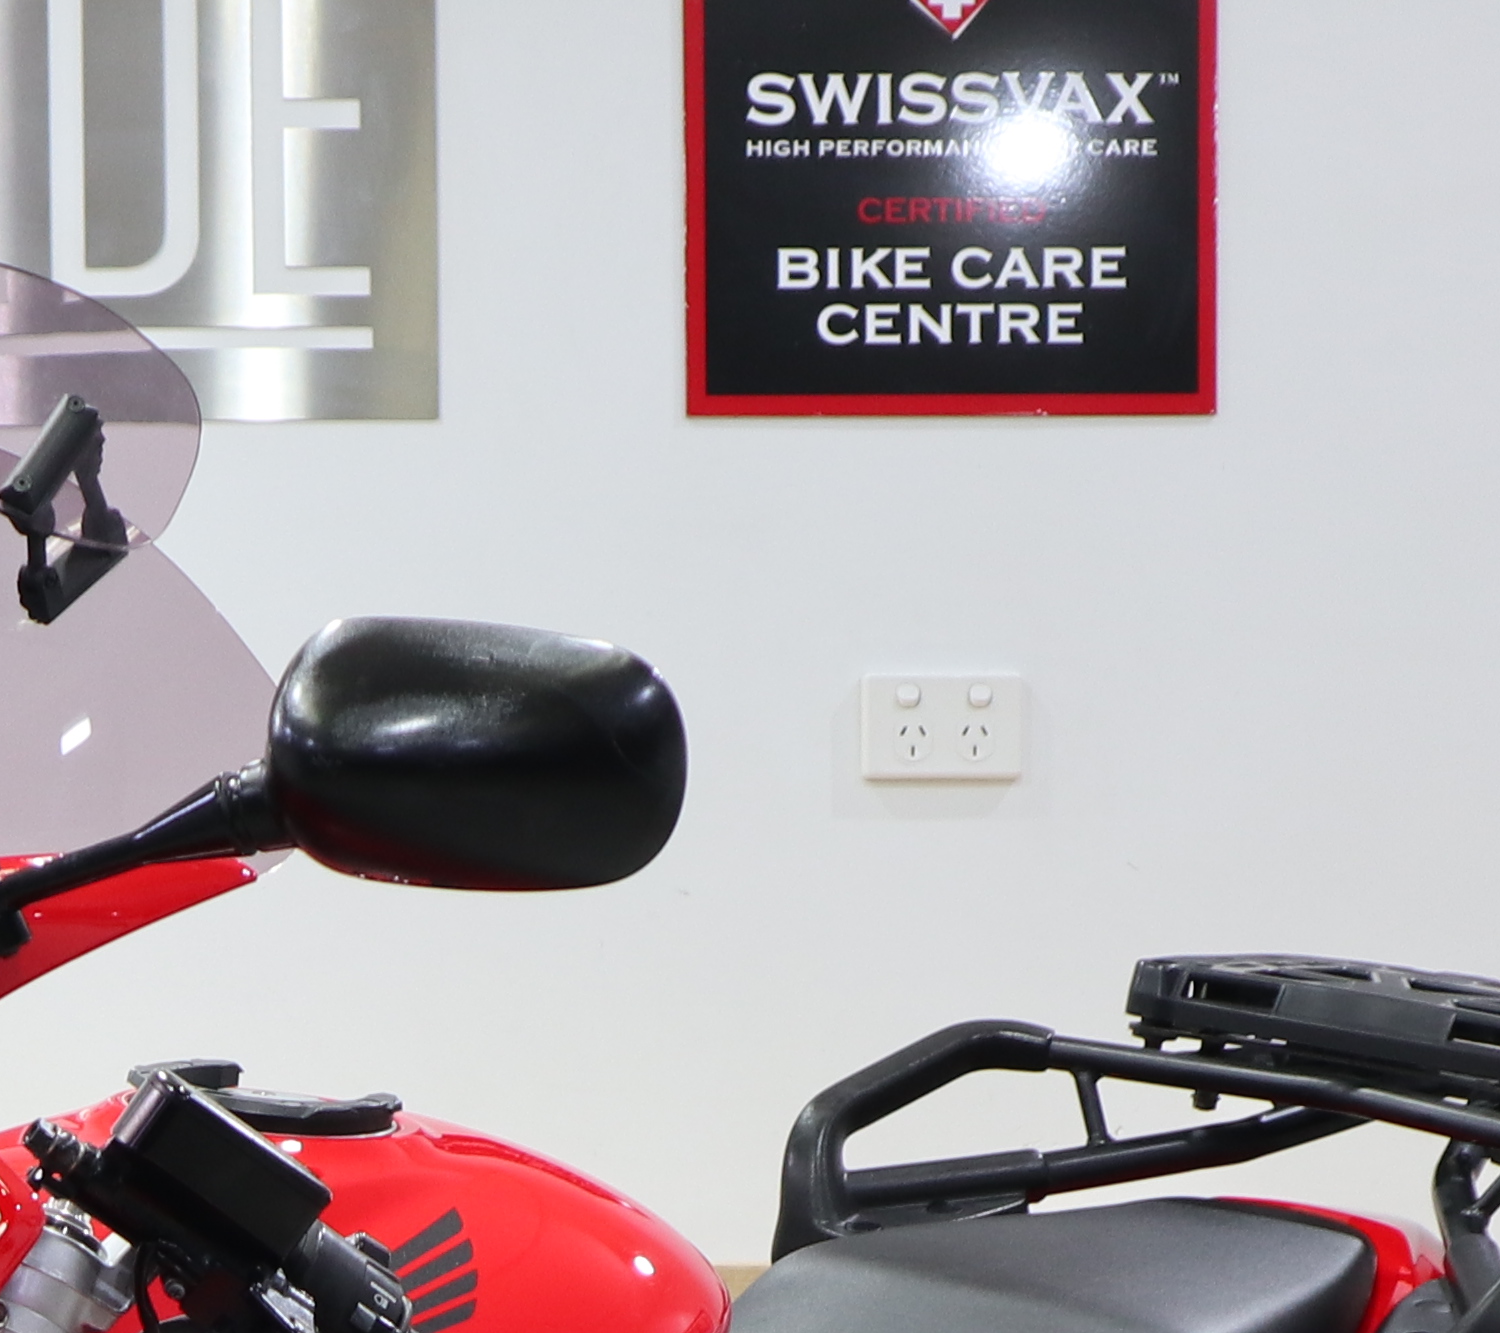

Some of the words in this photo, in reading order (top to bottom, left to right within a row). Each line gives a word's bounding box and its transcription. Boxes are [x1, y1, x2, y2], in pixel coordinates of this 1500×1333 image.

[746, 138, 810, 158] HIGH
[1087, 138, 1158, 158] CARE
[857, 197, 1047, 224] CERTIFIED
[776, 246, 932, 290] BIKE
[951, 246, 1127, 290] CARE
[816, 302, 1085, 346] CENTRE
